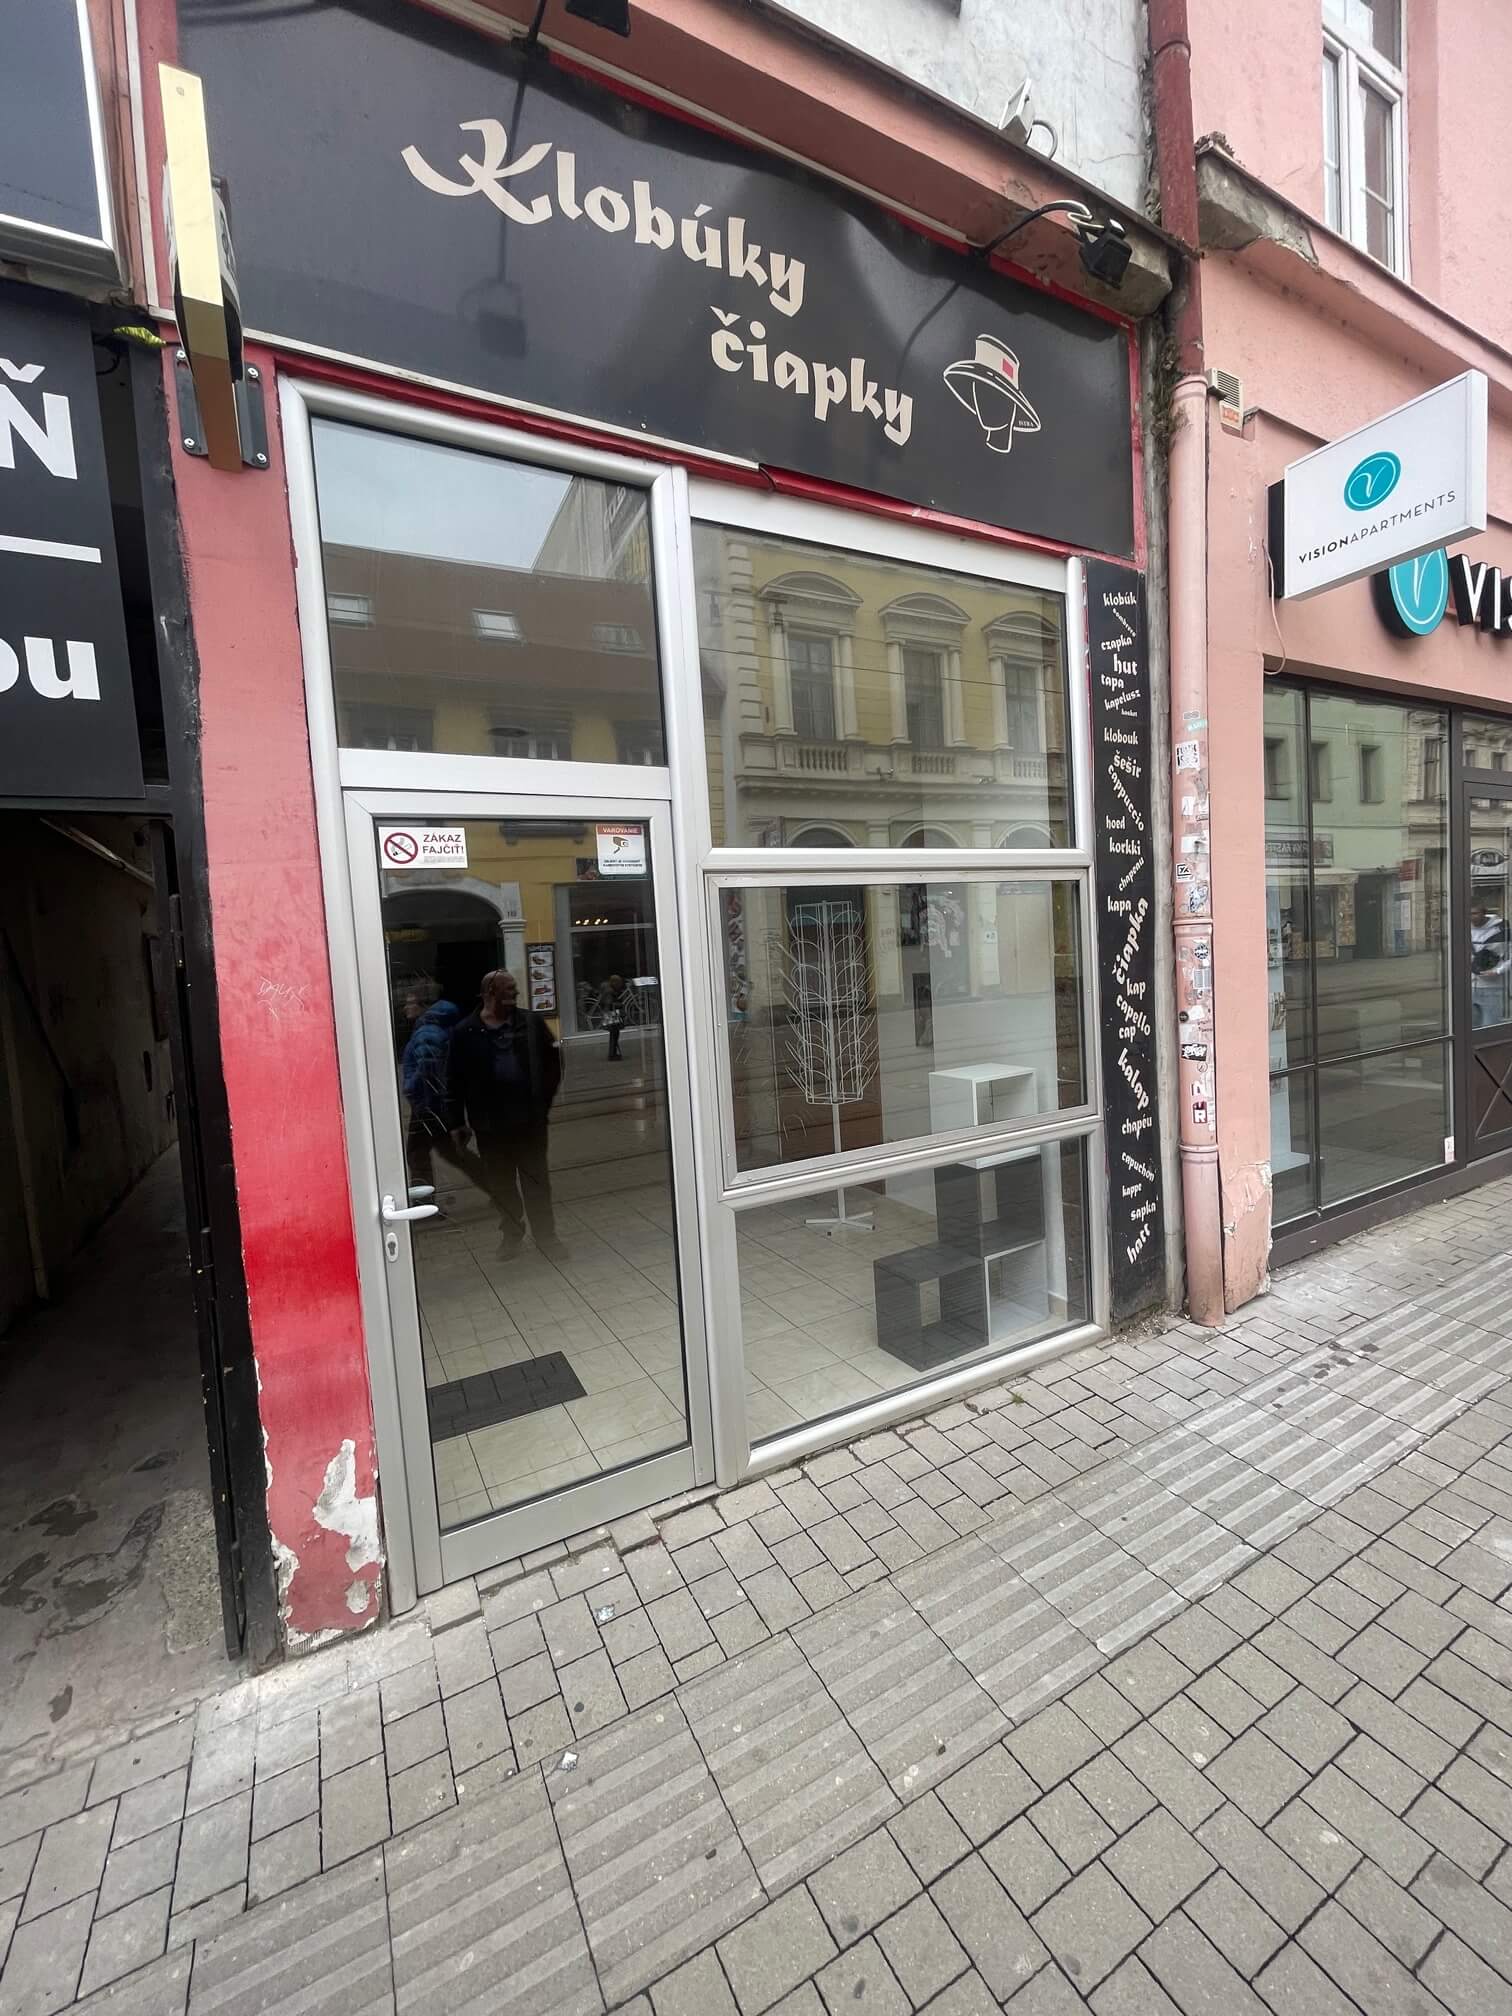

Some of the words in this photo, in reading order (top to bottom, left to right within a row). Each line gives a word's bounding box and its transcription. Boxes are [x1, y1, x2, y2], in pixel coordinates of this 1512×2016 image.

[400, 118, 805, 317] Klobúky
[710, 305, 913, 447] čiapky
[1299, 490, 1457, 563] VISIONAPARTMENTS
[1103, 591, 1137, 607] klobúk
[1461, 554, 1512, 637] VI
[1101, 634, 1133, 652] czapka
[1113, 653, 1138, 676] hut
[1101, 673, 1125, 692] tapa
[1104, 689, 1141, 711] kapelusz
[1103, 727, 1139, 745] klobouk
[1113, 749, 1142, 779] šešir
[1108, 764, 1145, 832] cappuccio
[1105, 815, 1126, 830] hoed
[423, 832, 462, 843] ZÁKAZ
[1109, 836, 1141, 856] korkki
[1118, 857, 1144, 892] chapeau
[1107, 896, 1132, 917] kapa
[1112, 897, 1149, 985] čiapka
[1126, 978, 1146, 1000] kap
[1116, 994, 1151, 1037] capello
[1118, 1025, 1137, 1043] cap
[1117, 1048, 1149, 1111] kalap
[1121, 1113, 1153, 1141] chapéu
[1121, 1152, 1155, 1182] capuchon
[1122, 1183, 1142, 1199] kappe
[1126, 1223, 1151, 1265] hatt
